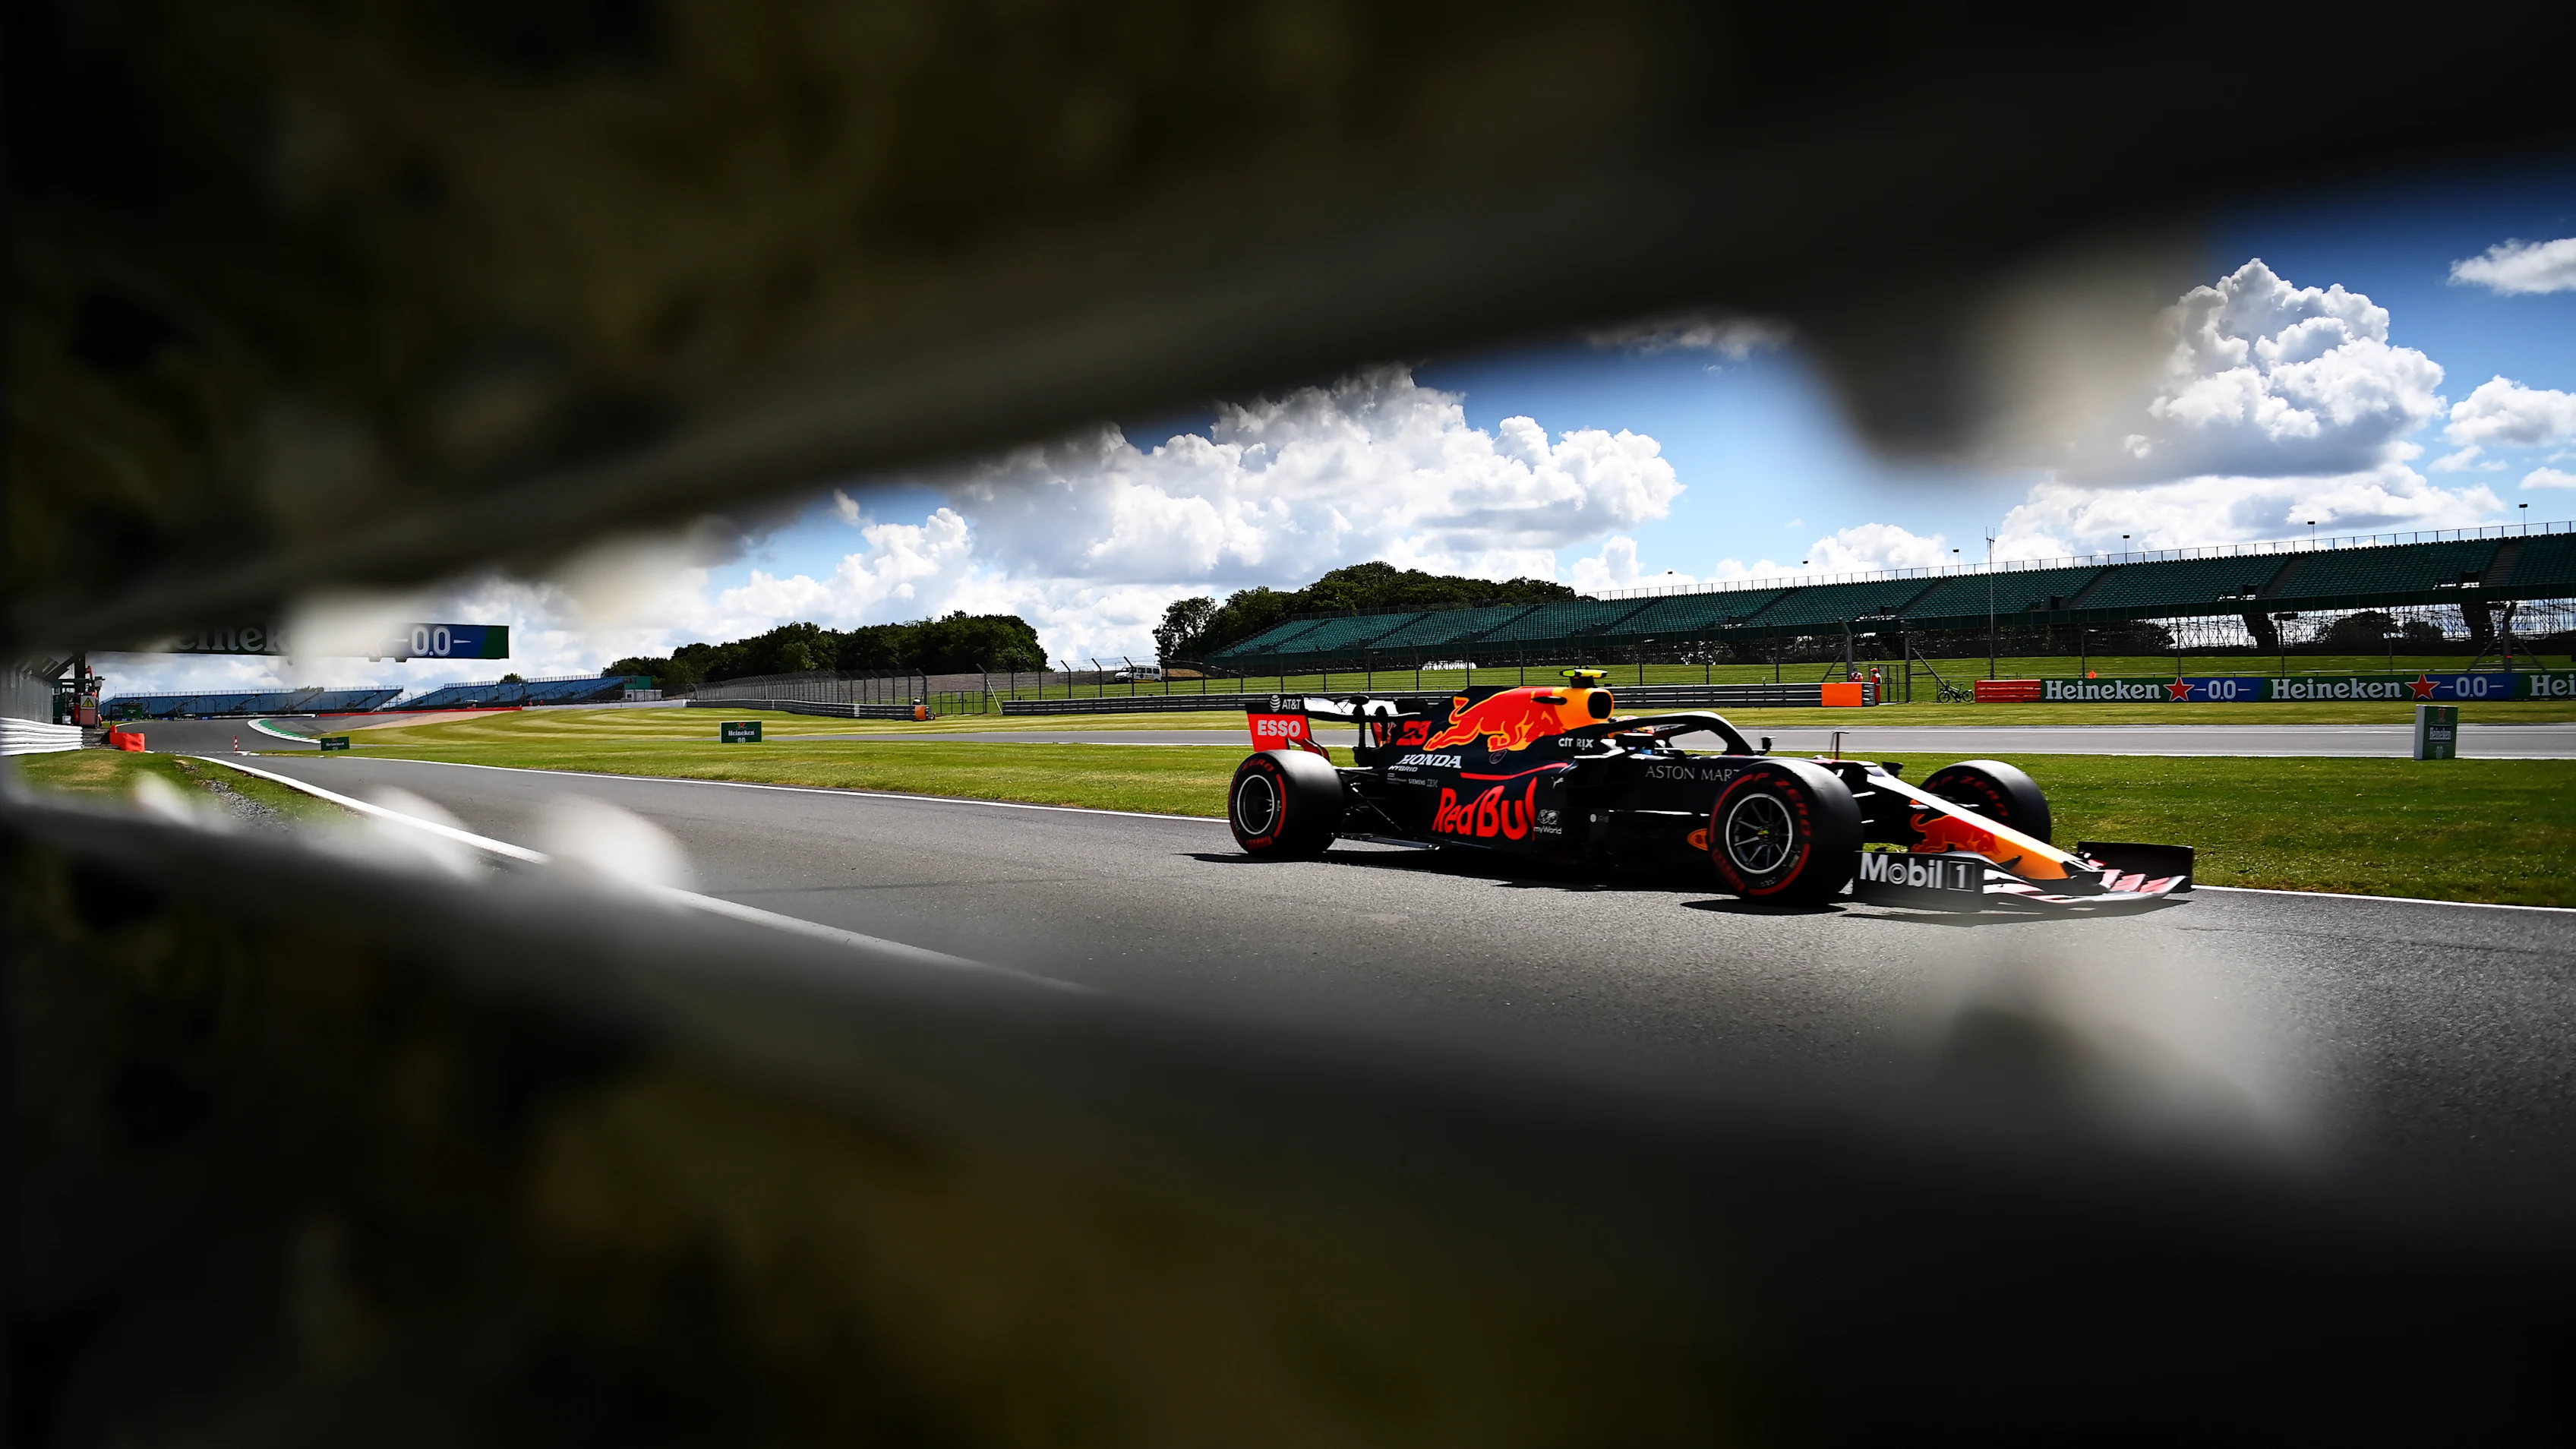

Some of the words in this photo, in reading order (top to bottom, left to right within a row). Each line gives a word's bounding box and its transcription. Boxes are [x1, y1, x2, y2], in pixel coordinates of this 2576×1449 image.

[2045, 680, 2161, 700] Heineken
[2271, 677, 2402, 699] Heineken
[2529, 674, 2576, 696] Hei
[1281, 698, 1302, 711] AT&T
[1257, 719, 1301, 737] ESSO
[1396, 720, 1433, 747] 23
[1395, 753, 1463, 769] HONDA
[1645, 766, 1695, 780] ASTON
[1476, 778, 1537, 841] Bul
[1533, 826, 1562, 835] myWorld
[1860, 852, 1942, 889] Mobil
